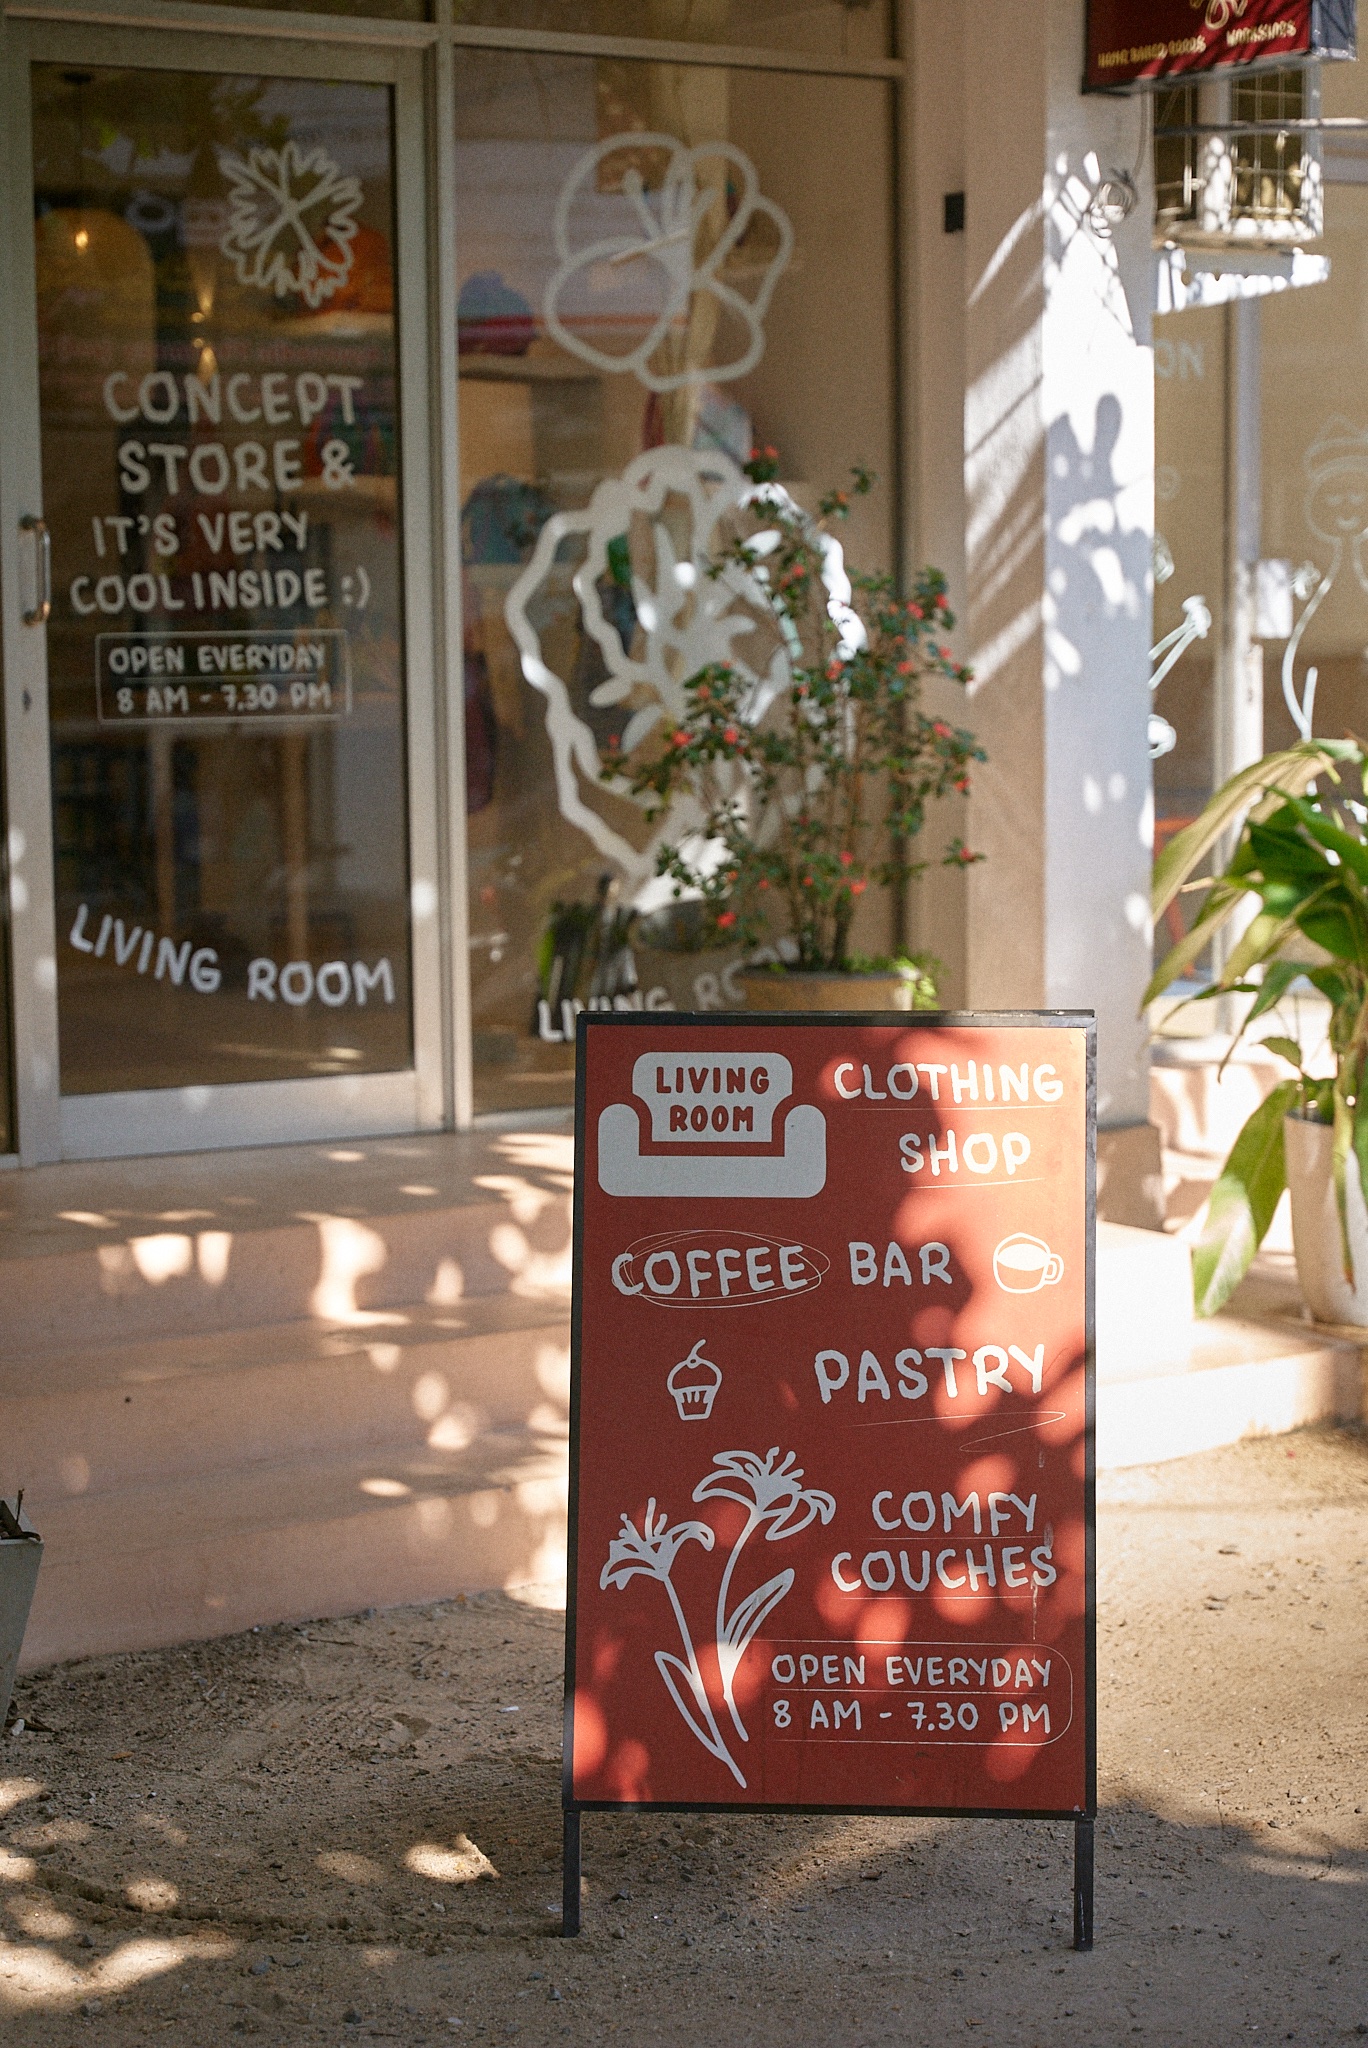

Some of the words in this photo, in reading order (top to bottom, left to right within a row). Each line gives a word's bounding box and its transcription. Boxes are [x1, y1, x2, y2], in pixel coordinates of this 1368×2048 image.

[103, 371, 364, 425] CONCEPT
[118, 439, 304, 496] STORE
[321, 439, 356, 490] &
[199, 511, 308, 554] VERY
[70, 574, 184, 615] COOL
[190, 568, 328, 610] INSIDE
[109, 645, 186, 676] OPEN
[198, 642, 325, 675] EVERYDAY
[116, 688, 134, 714] 8
[145, 684, 190, 713] AM
[219, 682, 277, 712] 7.30
[288, 681, 332, 710] PM
[69, 903, 222, 994] LIVING
[247, 957, 396, 1007] ROOM
[656, 1066, 770, 1094] LIVING
[834, 1060, 1064, 1103] CLOTHING
[669, 1105, 754, 1133] ROOM
[900, 1130, 1032, 1176] SHOP
[612, 1245, 808, 1297] COFFEE
[849, 1241, 953, 1288] BAR
[814, 1344, 1045, 1404] PASTRY
[871, 1491, 1038, 1537] COMFY
[831, 1544, 1057, 1592] COUCHES
[771, 1653, 865, 1685] OPEN
[886, 1656, 1051, 1688] EVERYDAY
[773, 1700, 792, 1728] 8
[810, 1700, 862, 1731] AM
[907, 1702, 979, 1731] 7.30
[999, 1702, 1050, 1734] PM
